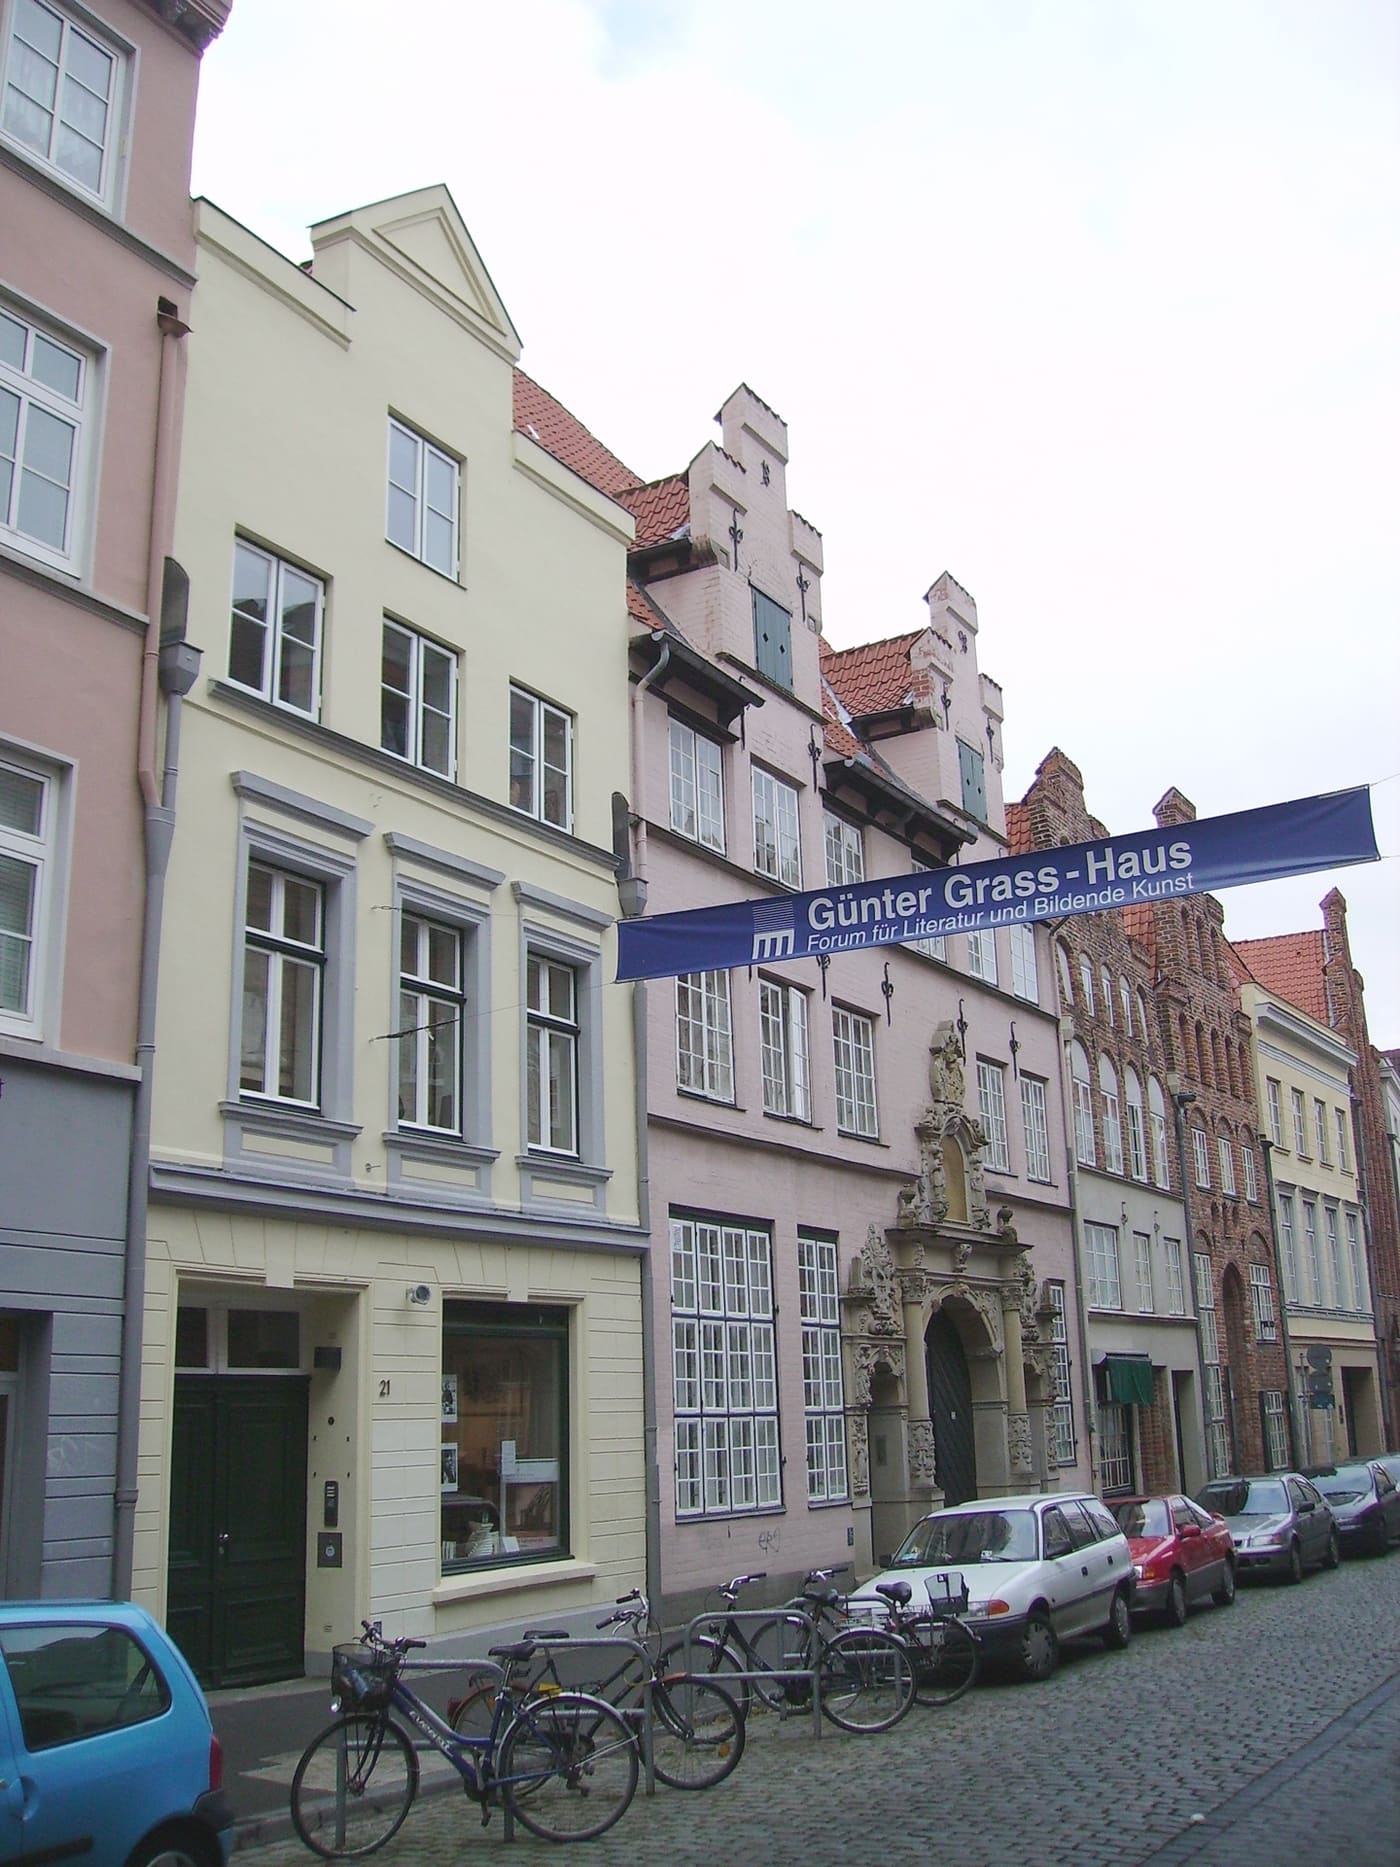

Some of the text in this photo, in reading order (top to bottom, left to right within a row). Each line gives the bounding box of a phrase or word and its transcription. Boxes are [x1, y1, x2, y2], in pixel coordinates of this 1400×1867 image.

[807, 872, 1194, 951] Forum für Literatur und Bildende Kunst
[808, 887, 932, 931] Günter
[379, 1379, 391, 1397] 21
